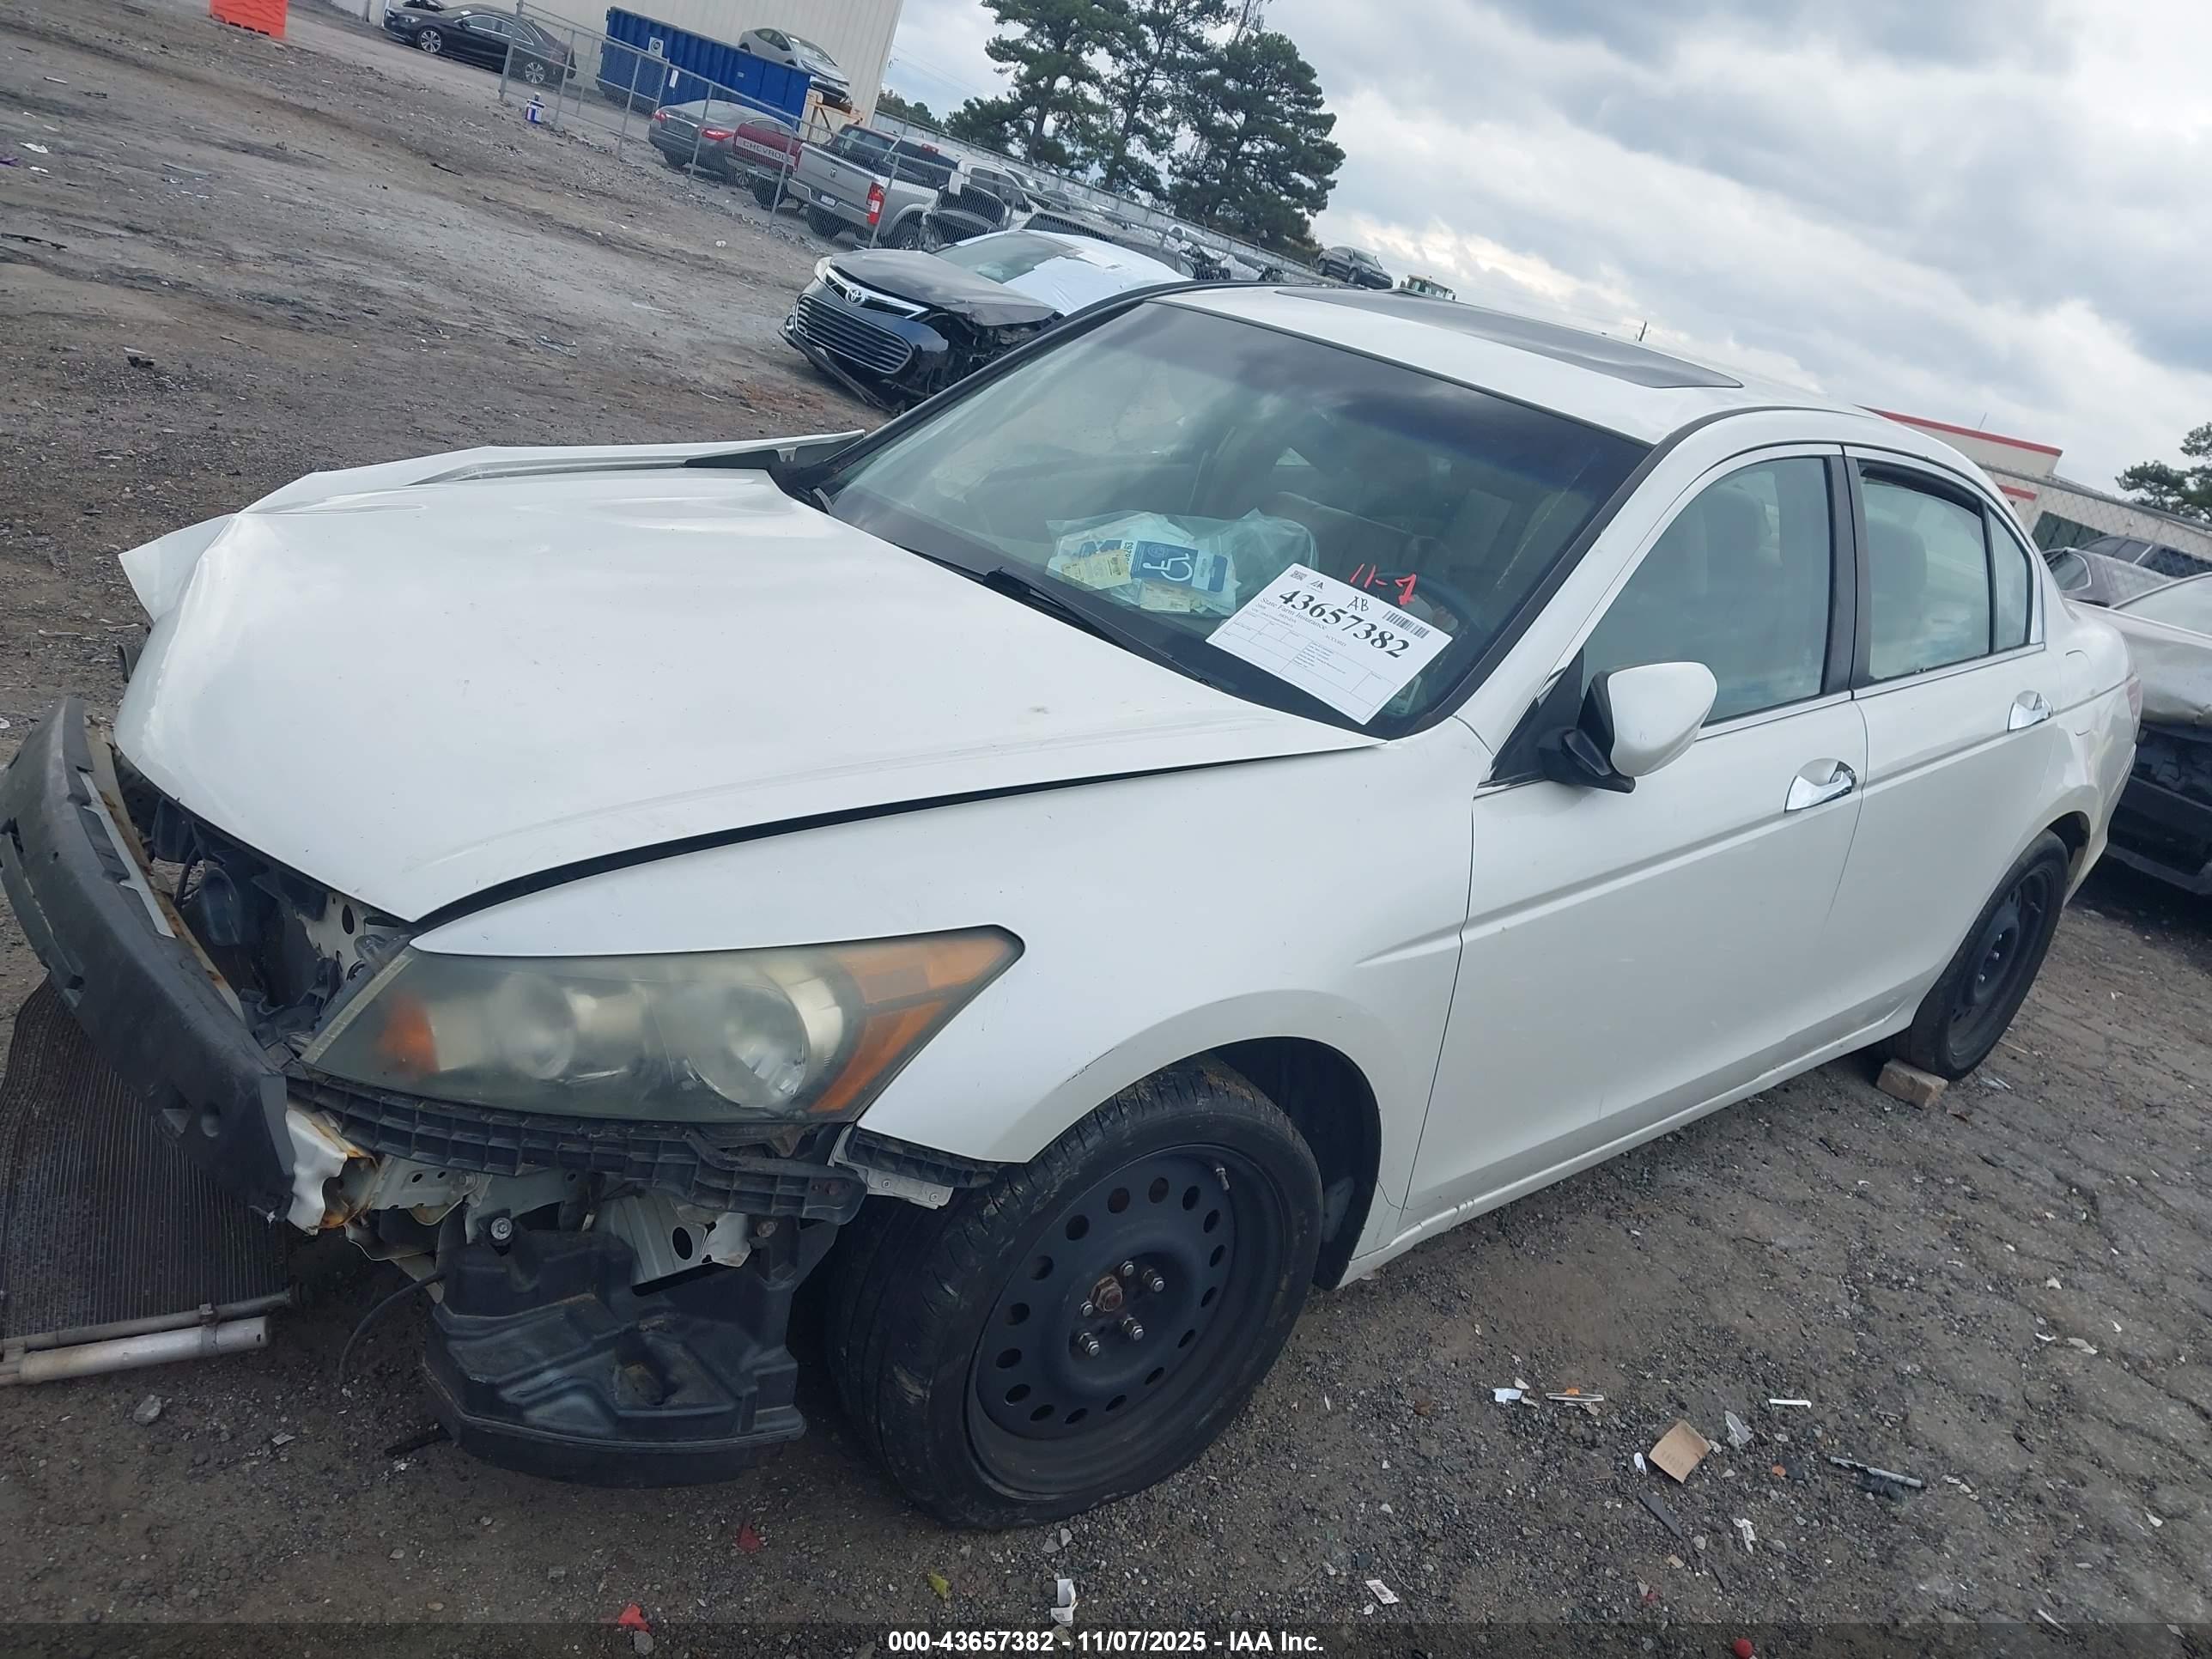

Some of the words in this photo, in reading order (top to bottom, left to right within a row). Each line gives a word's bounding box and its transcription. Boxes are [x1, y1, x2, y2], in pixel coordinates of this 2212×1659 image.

[743, 139, 792, 164] CHEVROL
[1261, 598, 1278, 607] State
[1277, 605, 1295, 616] Farm
[1296, 612, 1328, 630] Insurance
[1279, 590, 1410, 659] 43657382
